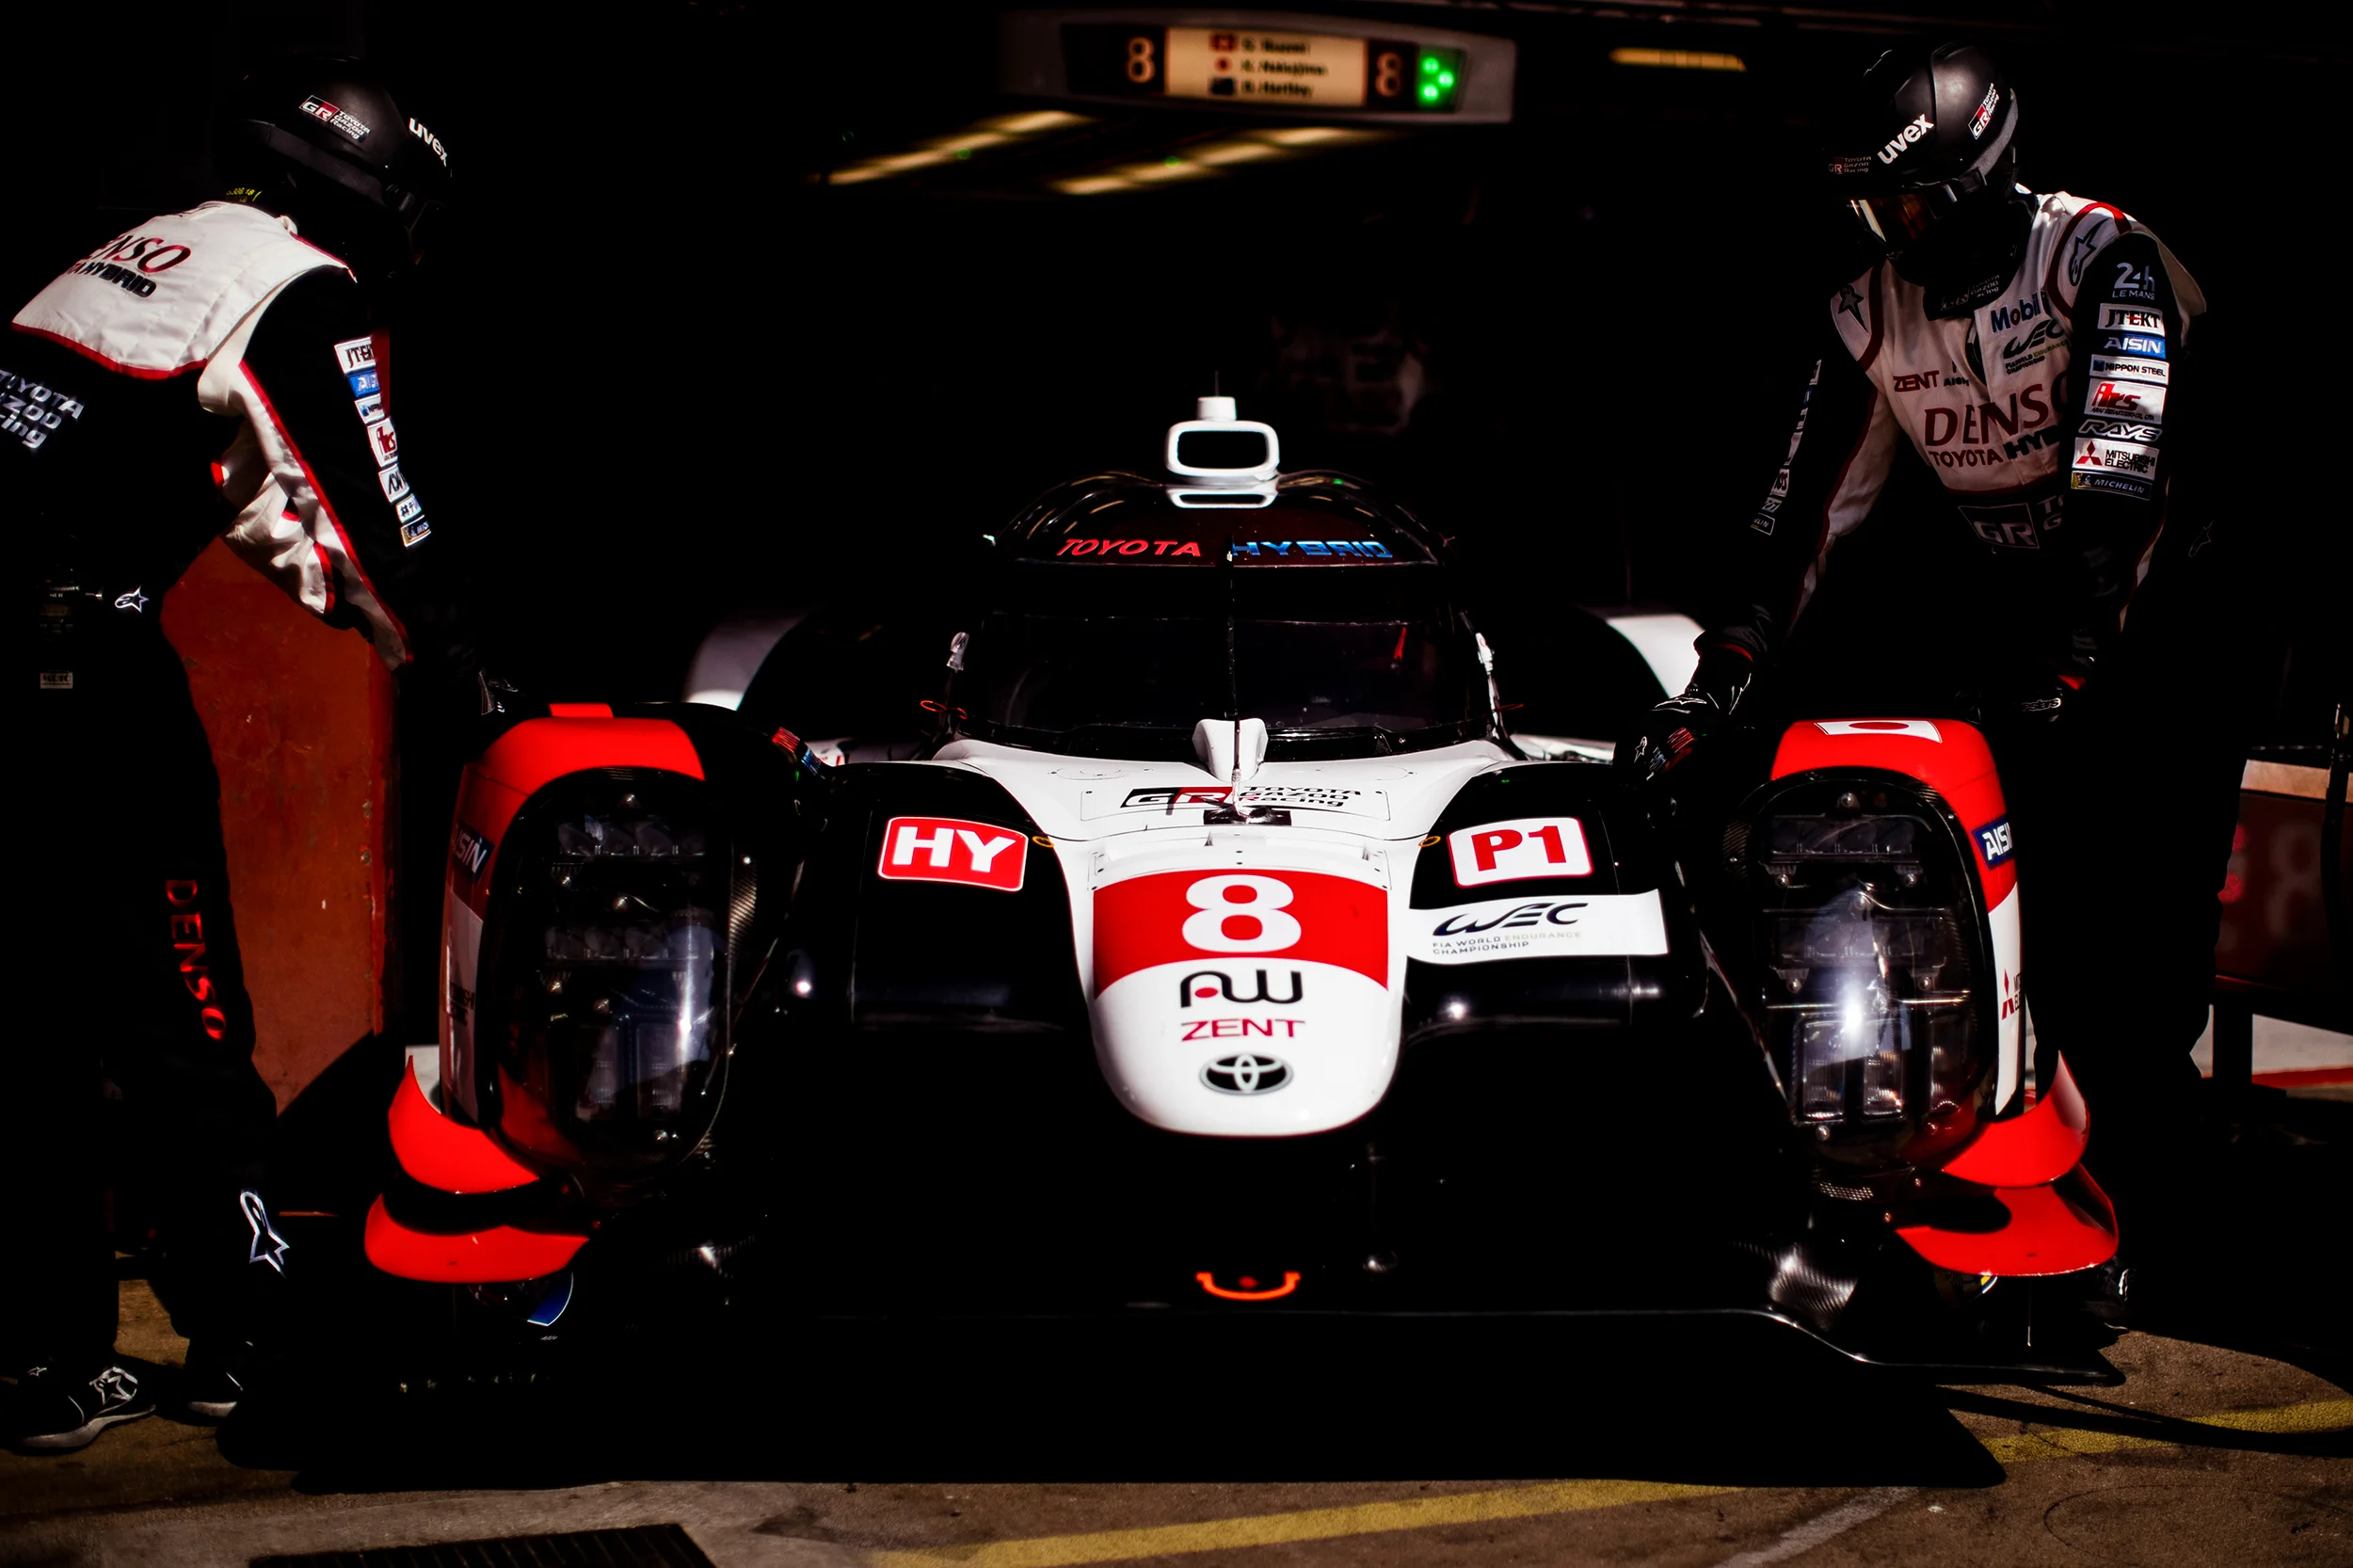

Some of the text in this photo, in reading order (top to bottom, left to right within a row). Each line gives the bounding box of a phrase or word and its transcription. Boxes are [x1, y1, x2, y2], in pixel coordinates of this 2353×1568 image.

[1128, 36, 1155, 83] 8
[1375, 52, 1401, 97] 8
[301, 101, 333, 120] GR
[330, 119, 360, 139] Racing
[334, 115, 364, 136] GAZOO
[339, 110, 371, 134] TOYOTA
[1973, 112, 1990, 137] GR
[408, 117, 448, 168] uvex
[1877, 114, 1935, 165] uvex
[79, 261, 157, 298] HYBRID
[2128, 289, 2155, 300] MANS
[1991, 292, 2041, 333] Mobil
[2105, 308, 2161, 328] JTEKT
[2104, 336, 2162, 354] AISIN
[2105, 362, 2166, 376] NIPPON STEEL
[1893, 370, 1940, 392] ZENT
[0, 392, 62, 429] ZOO
[2078, 419, 2163, 442] RAYS
[1928, 448, 2004, 469] TOYOTA
[2104, 458, 2149, 473] ELECTRIC
[2105, 449, 2156, 467] MITSUBISHI
[2094, 478, 2145, 494] MICHELIN
[1973, 520, 2037, 546] GR
[1055, 539, 1394, 558] TOYOTA HYBRID
[1126, 792, 1227, 807] GR
[1239, 796, 1344, 807] Racing
[1240, 791, 1349, 800] GAZOO
[1243, 786, 1362, 795] TOYOTA
[892, 825, 1016, 873] HY
[1470, 825, 1566, 872] P1
[1981, 821, 2013, 861] AISI
[1181, 873, 1302, 953] 8
[1433, 902, 1589, 936] WEC
[1433, 940, 1529, 955] CHAMPIONSHIP
[1456, 936, 1501, 948] WORLD
[1504, 931, 1581, 941] ENDURANCE
[165, 878, 227, 1040] DENSO
[1180, 1017, 1305, 1042] ZENT
